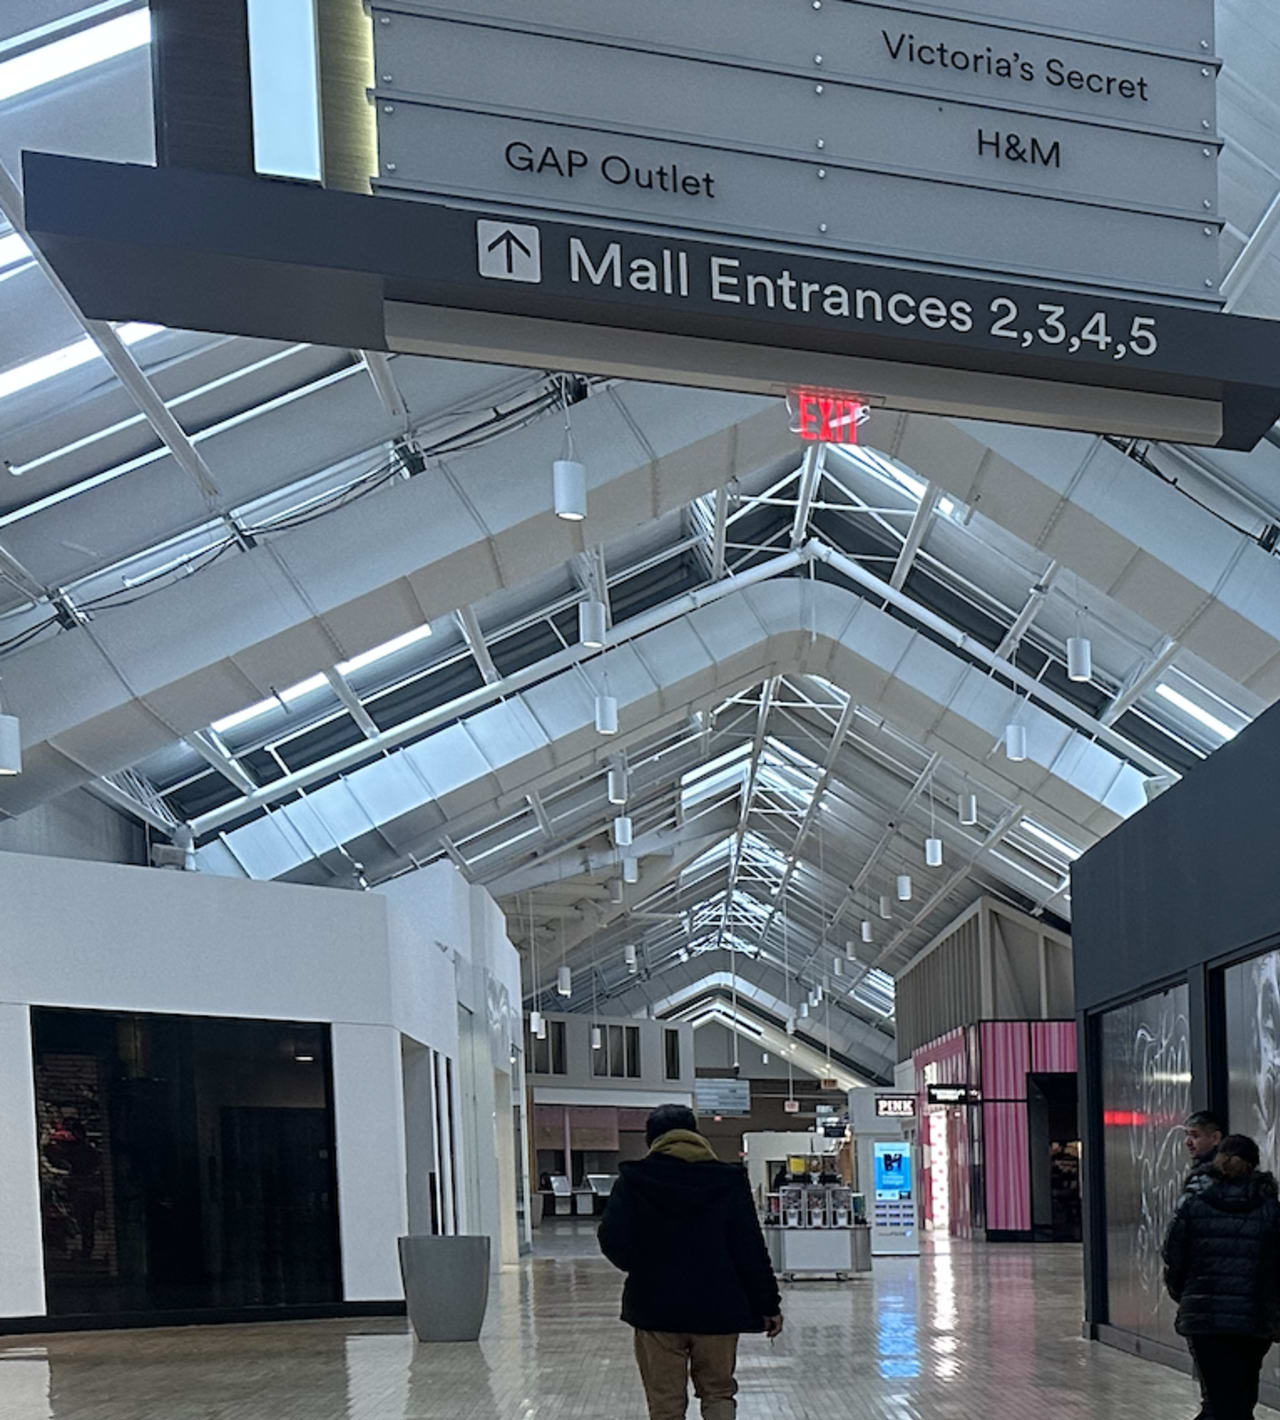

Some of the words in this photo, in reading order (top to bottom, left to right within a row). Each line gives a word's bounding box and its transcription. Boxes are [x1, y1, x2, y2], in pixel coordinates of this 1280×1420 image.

[881, 30, 1034, 81] Victoria's
[1045, 58, 1149, 101] Secret
[504, 141, 589, 177] GAP
[601, 155, 715, 198] Outlet
[977, 128, 1061, 168] H&M
[569, 237, 689, 297] Mall
[710, 256, 974, 332] Entrances
[989, 297, 1158, 360] 2,3,4,5
[799, 393, 861, 444] EXIT
[877, 1099, 914, 1112] PINK
